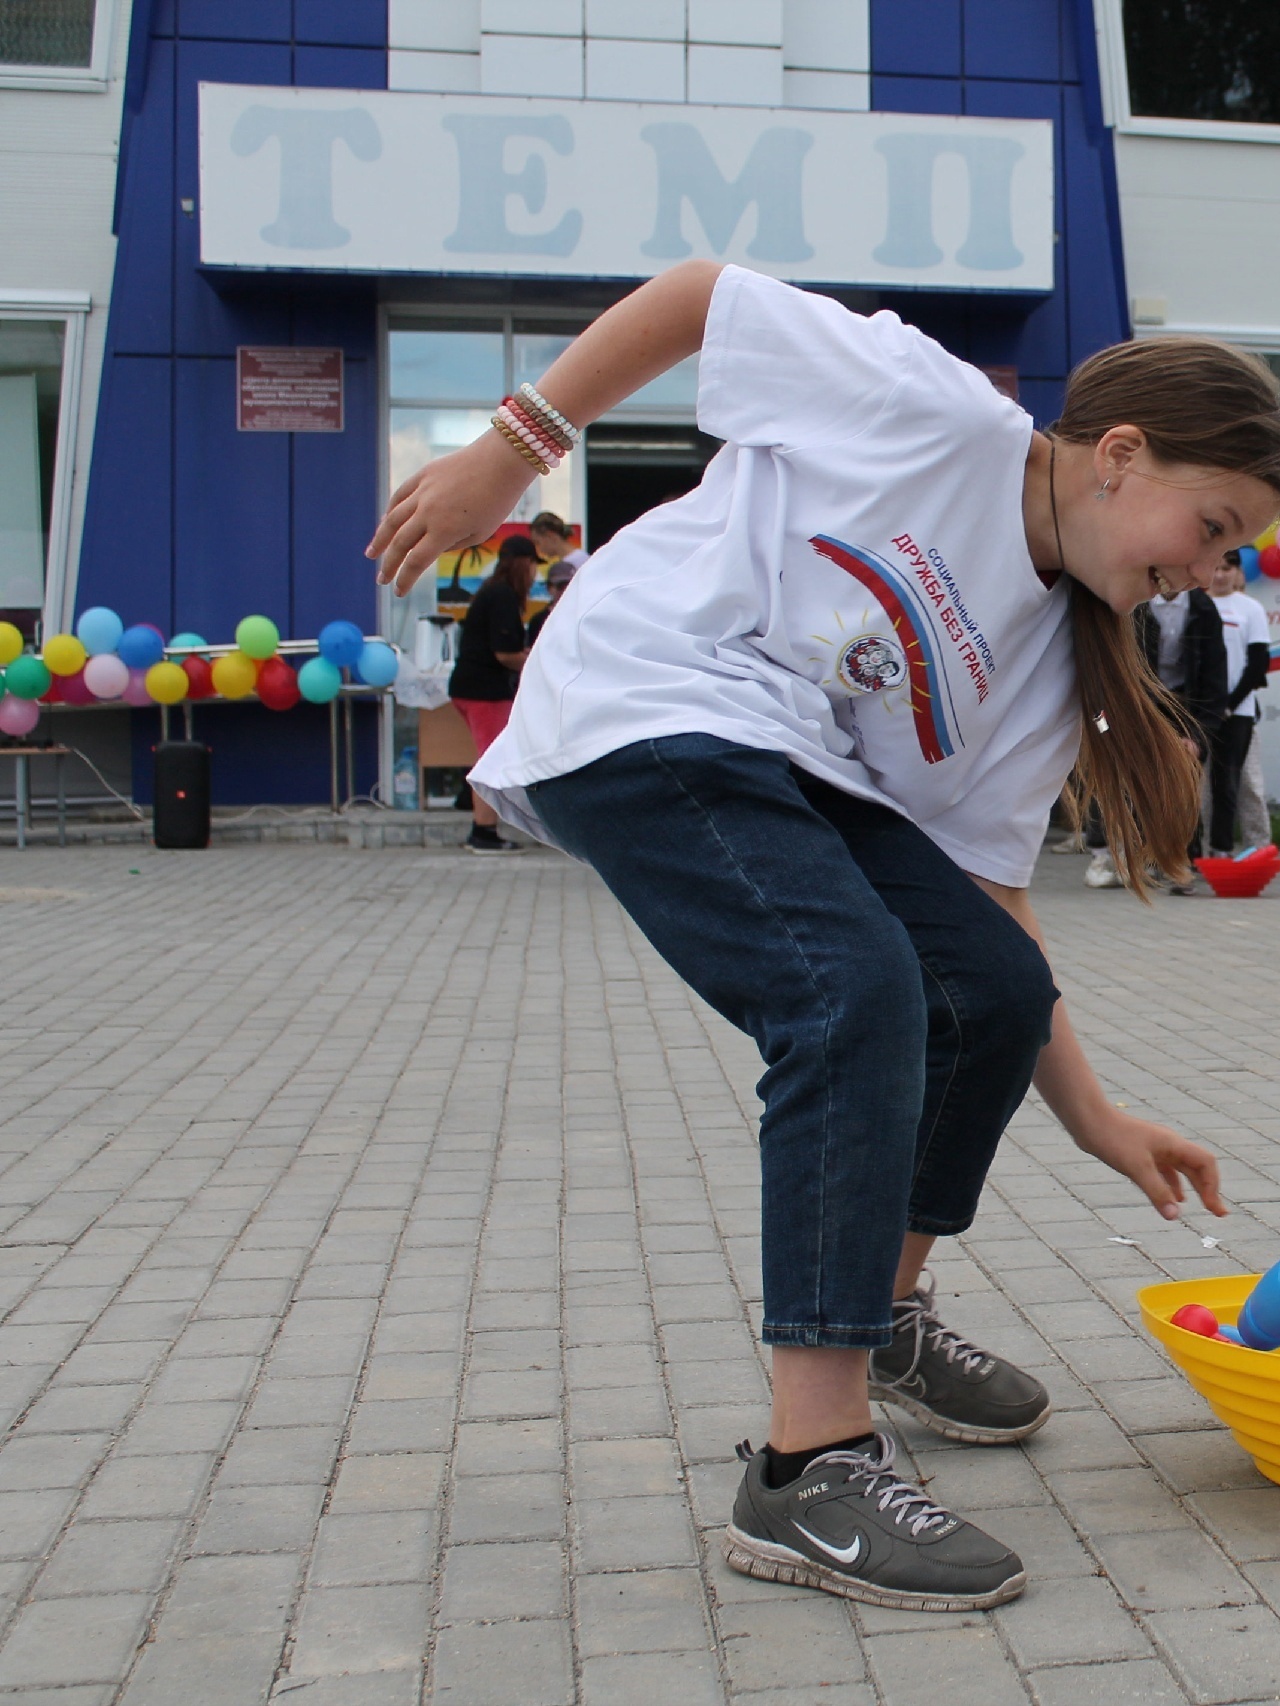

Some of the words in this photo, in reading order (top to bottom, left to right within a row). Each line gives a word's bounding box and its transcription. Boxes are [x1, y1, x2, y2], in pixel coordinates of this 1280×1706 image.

[229, 103, 1026, 271] ТЕМП
[891, 533, 946, 608] ДРУЖБА
[940, 606, 964, 643] БЕЗ
[958, 641, 989, 705] ГРАНИЦ
[927, 548, 979, 634] СОЦИАЛЬНЫЙ
[973, 633, 996, 675] ПРОЕКТ
[797, 1481, 829, 1501] NIKE
[934, 1518, 958, 1536] NIKE
